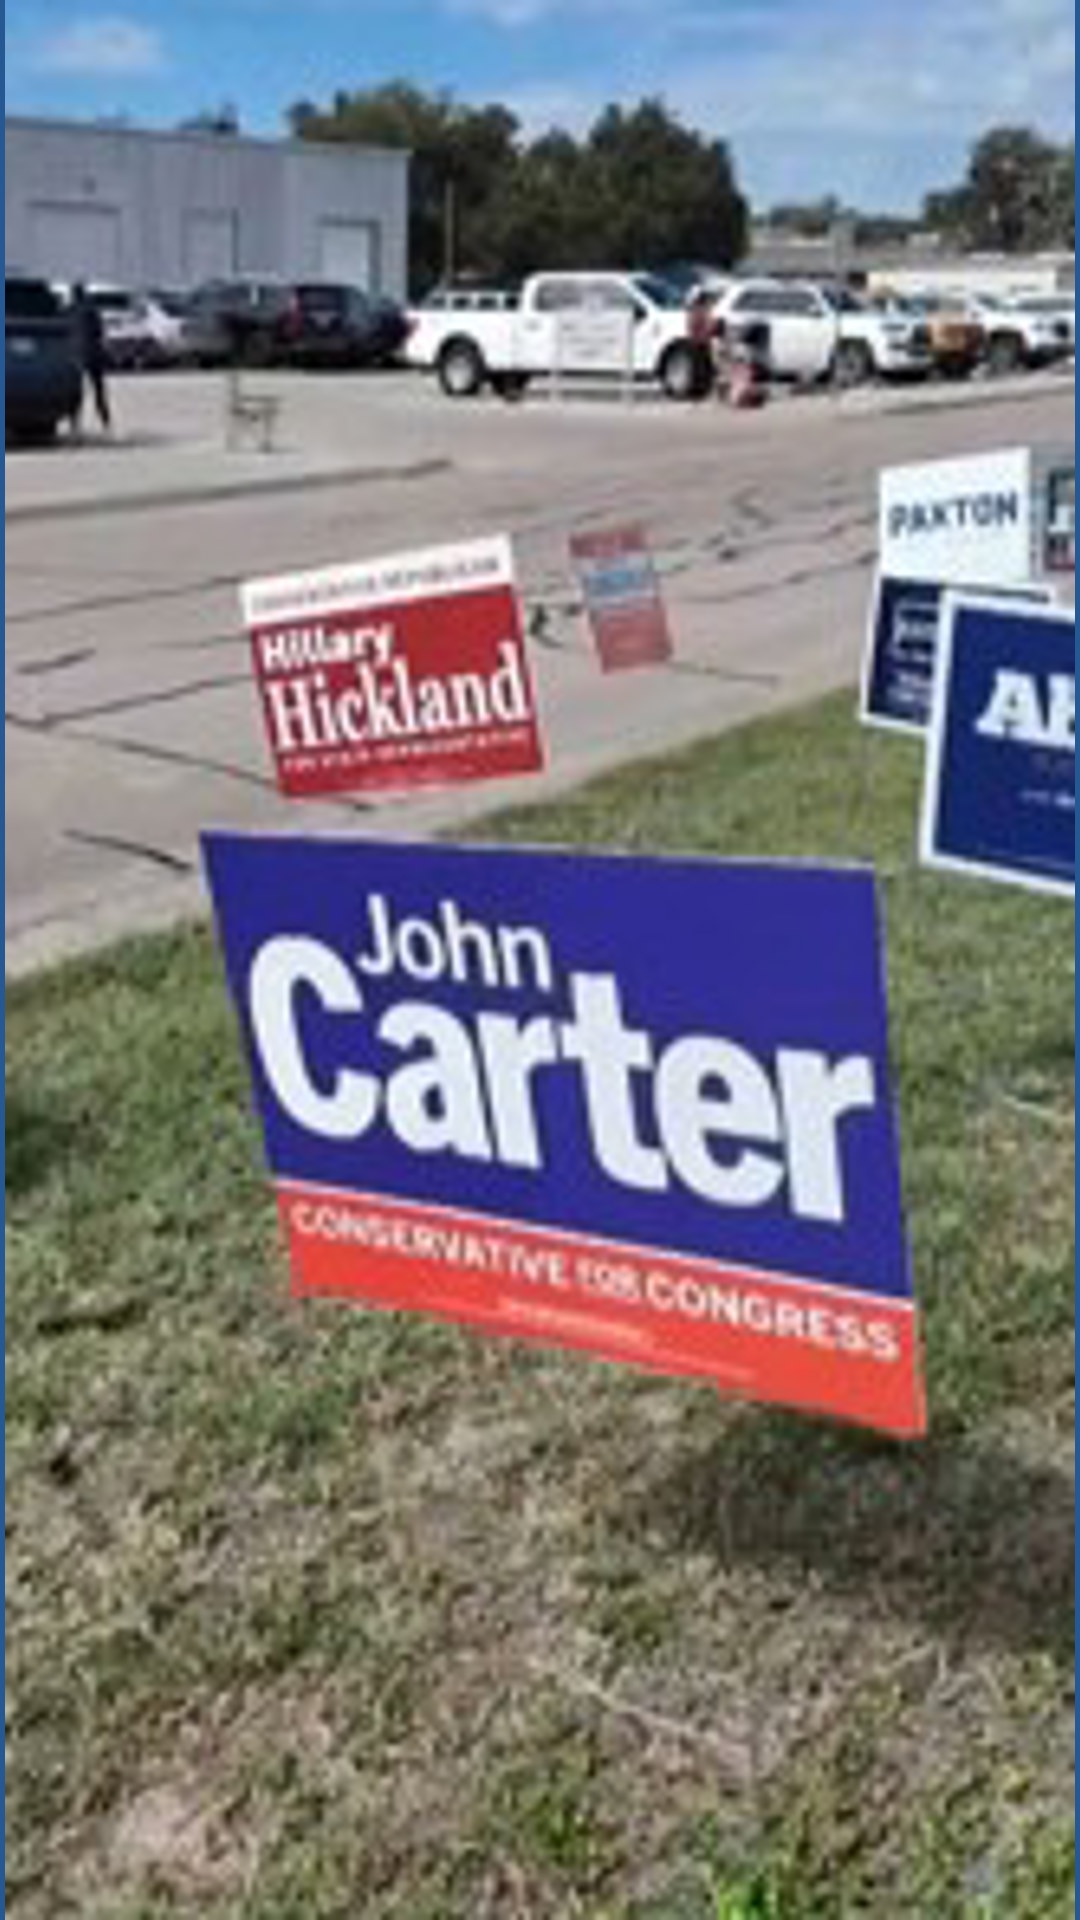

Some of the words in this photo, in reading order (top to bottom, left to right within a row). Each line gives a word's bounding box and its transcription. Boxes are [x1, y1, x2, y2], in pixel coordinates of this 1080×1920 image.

[889, 490, 1017, 538] PAXTON
[262, 624, 392, 671] Hillary
[267, 641, 527, 748] Hickland
[358, 893, 553, 992] John
[249, 934, 876, 1223] Carter
[291, 1202, 567, 1287] CONSERVATIVE
[645, 1269, 899, 1361] CONGRESS
